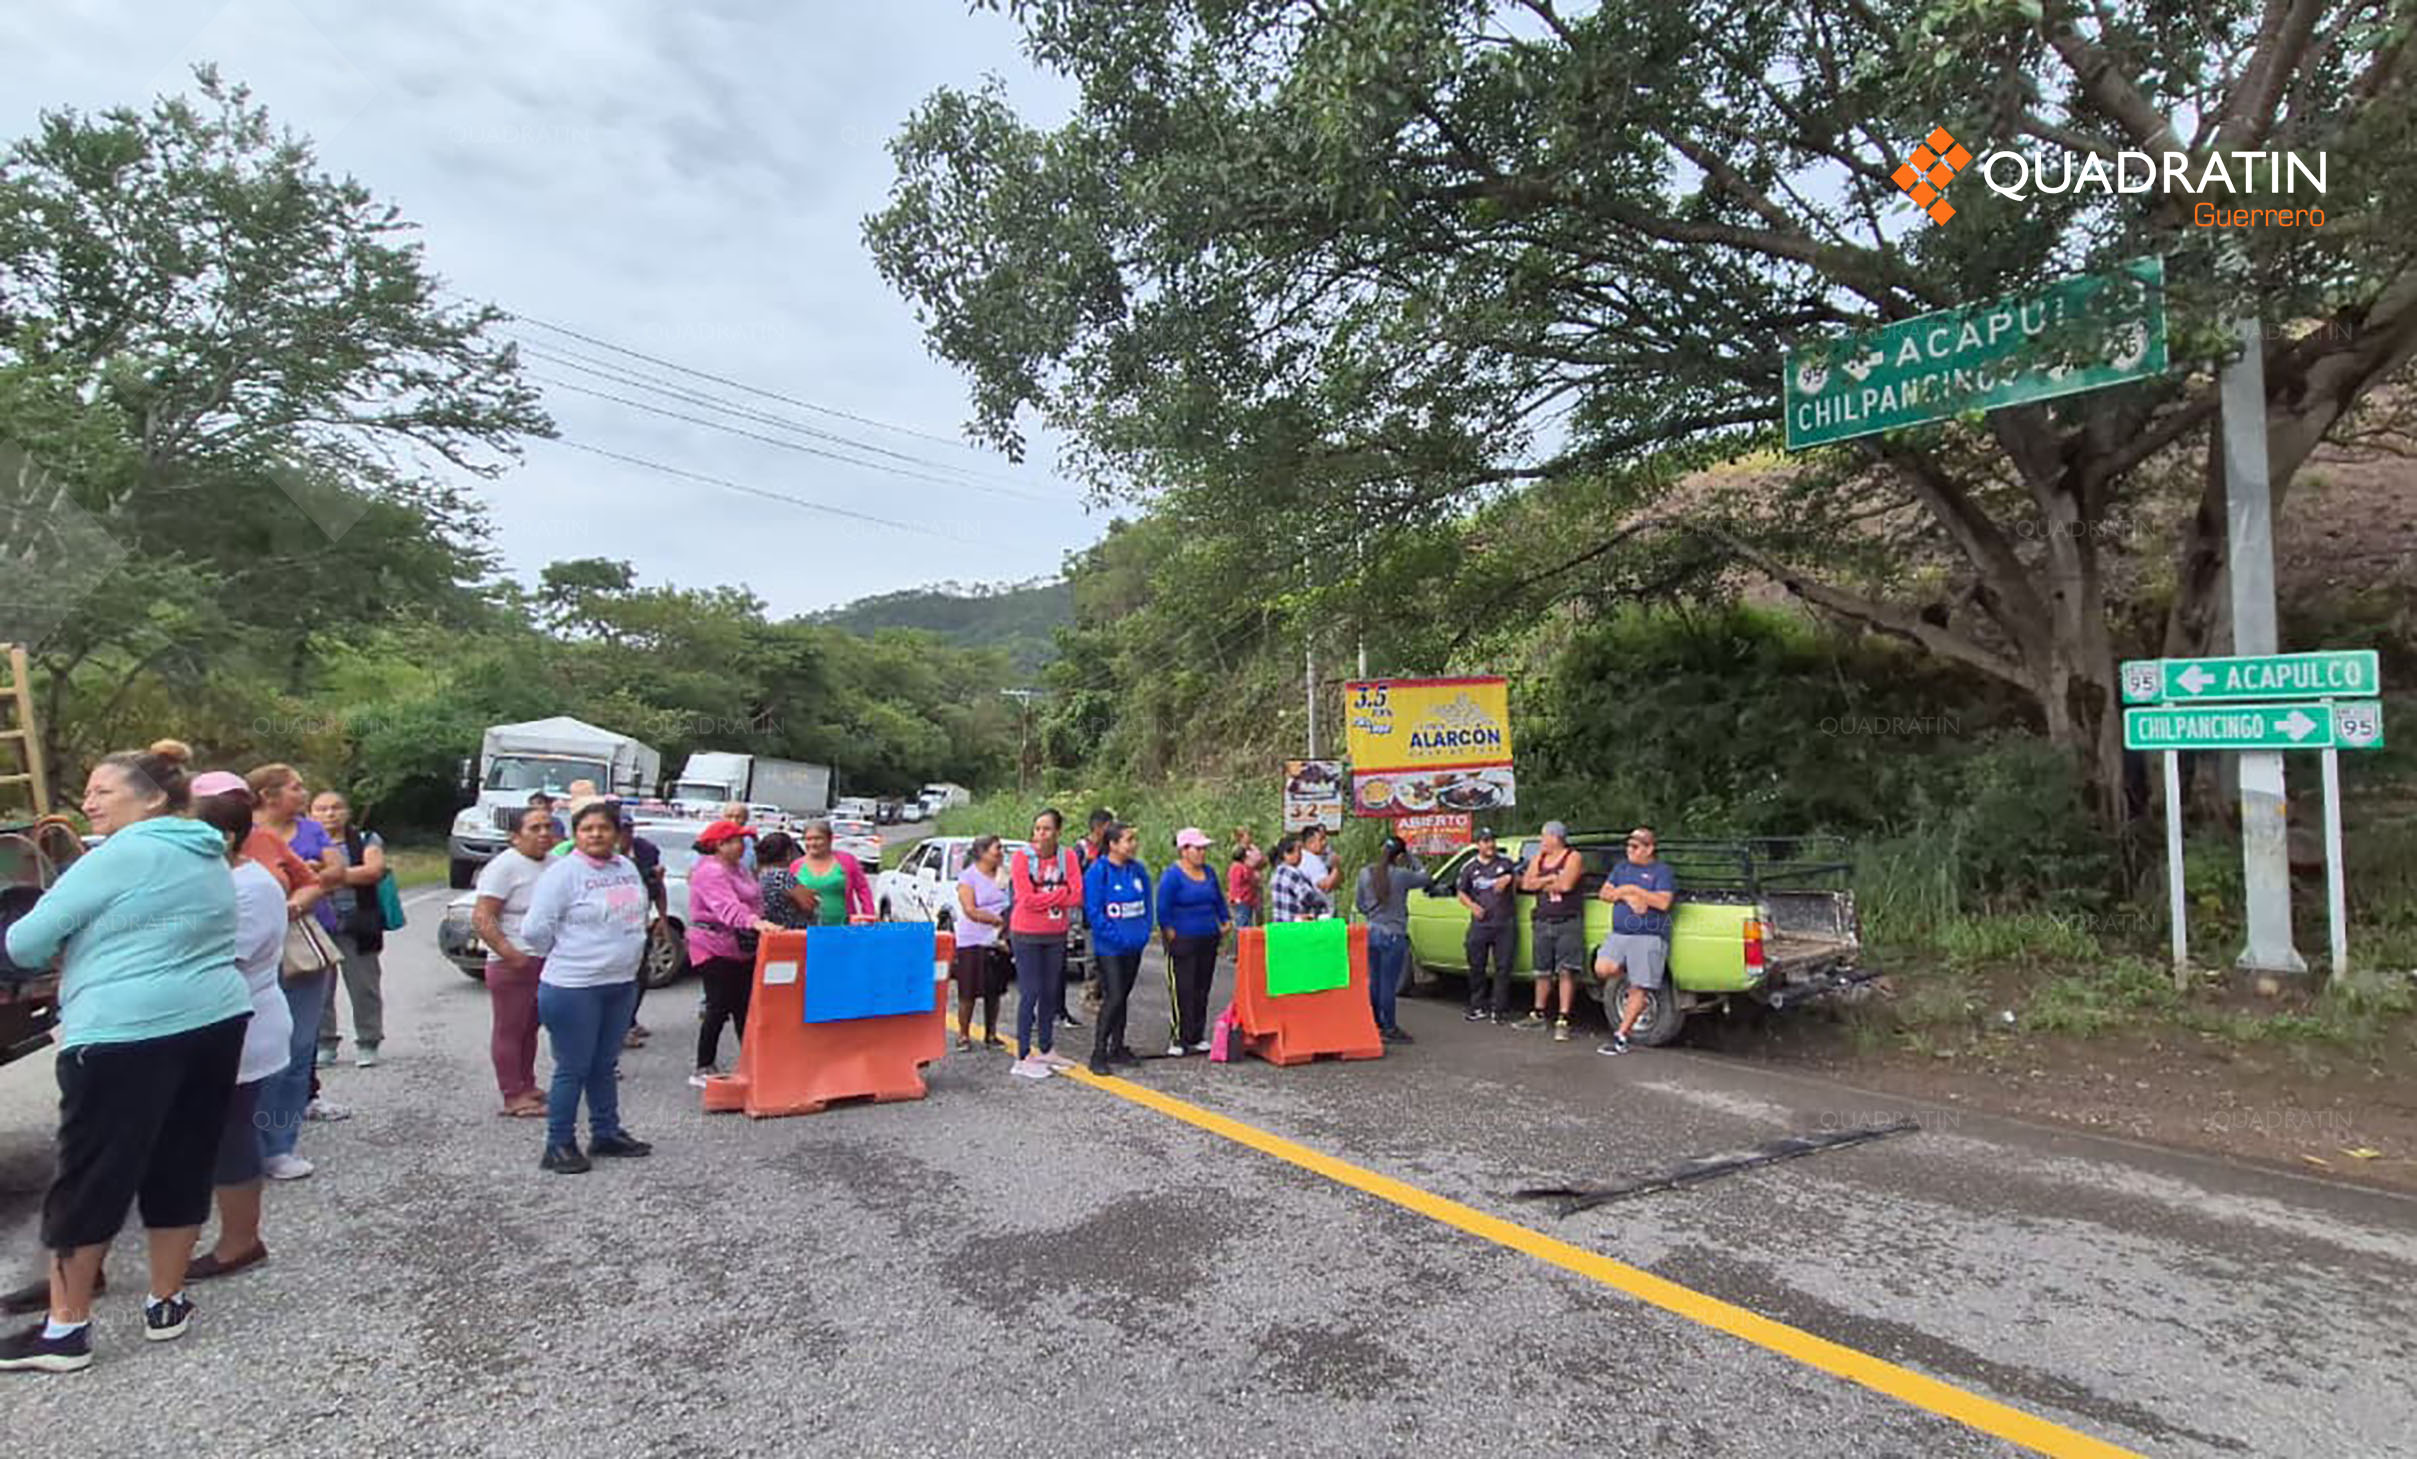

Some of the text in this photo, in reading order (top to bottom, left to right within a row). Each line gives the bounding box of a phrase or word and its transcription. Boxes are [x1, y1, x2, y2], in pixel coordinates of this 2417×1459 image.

[2130, 660, 2363, 691] 95 ACAPULCO
[1410, 722, 1501, 748] ALARCÓN
[2138, 714, 2372, 741] CHILPANCINGO 95
[1397, 814, 1468, 830] ABIERTO
